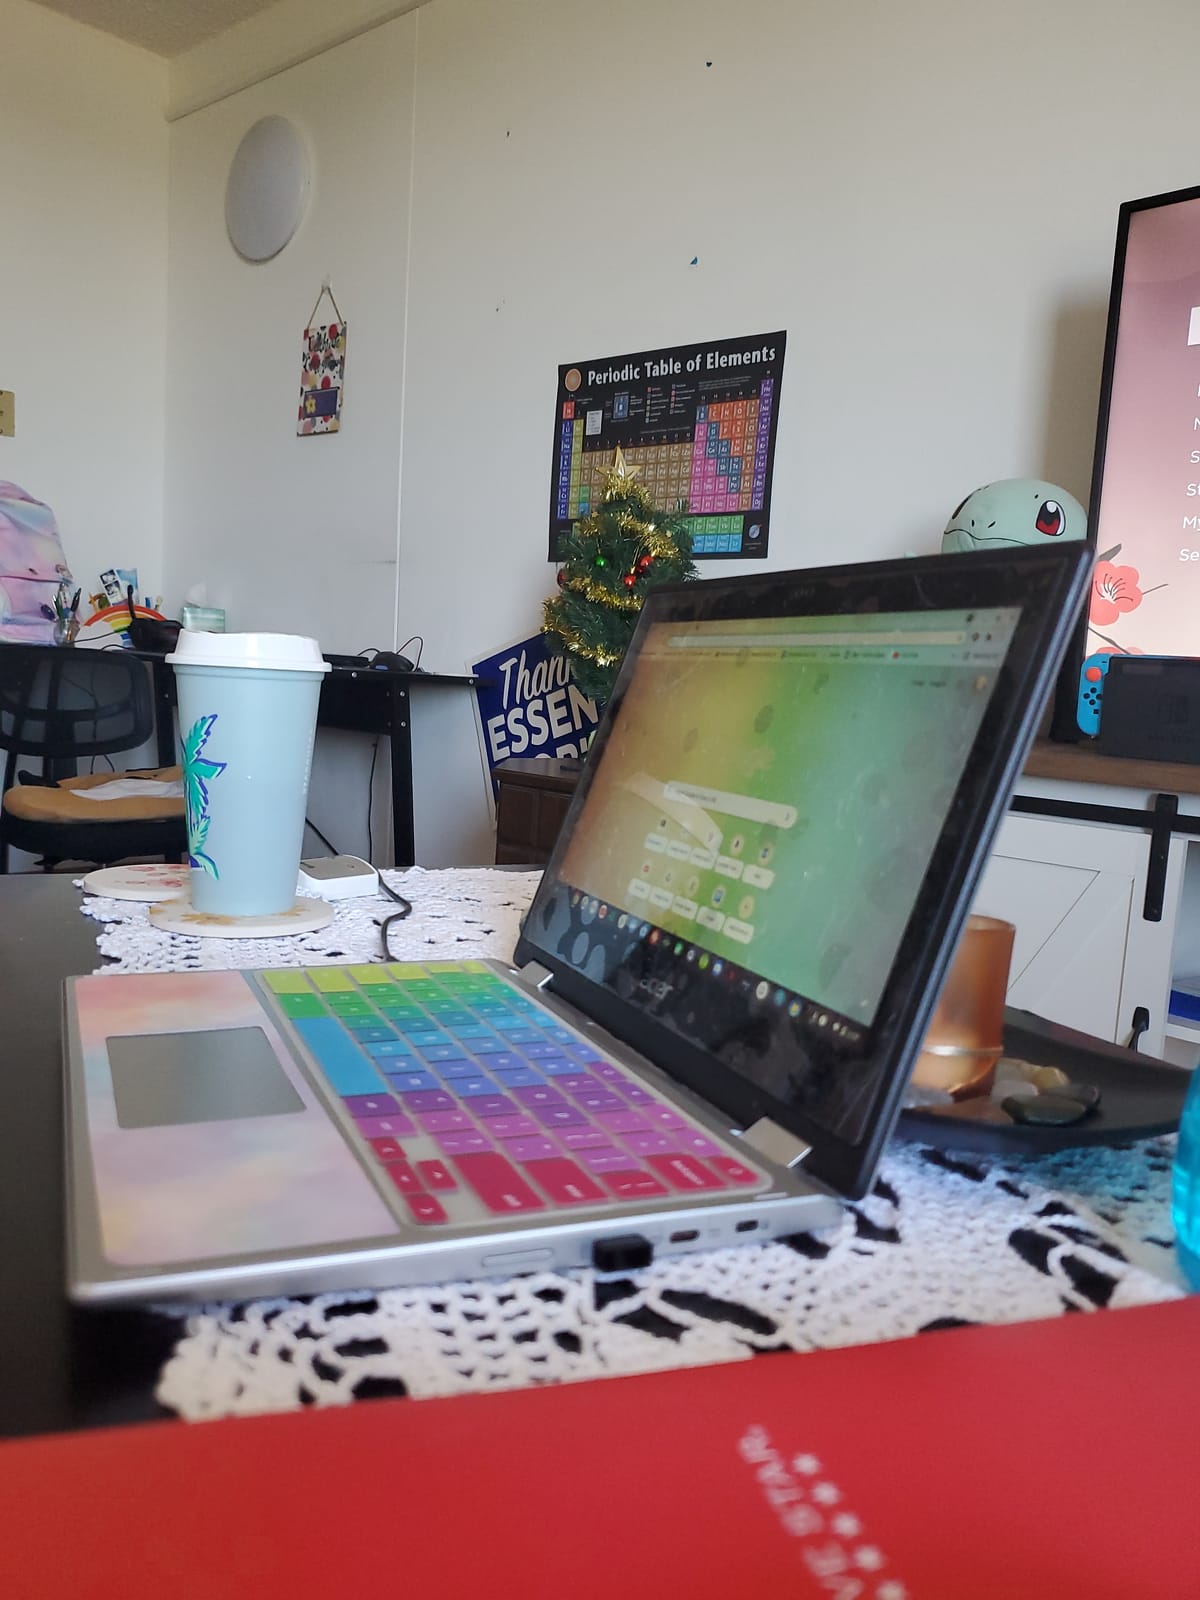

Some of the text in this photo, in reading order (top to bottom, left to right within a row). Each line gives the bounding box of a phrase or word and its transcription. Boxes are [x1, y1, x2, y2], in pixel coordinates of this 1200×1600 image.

[587, 346, 776, 386] Periodic Table of Elements
[498, 649, 571, 710] Than
